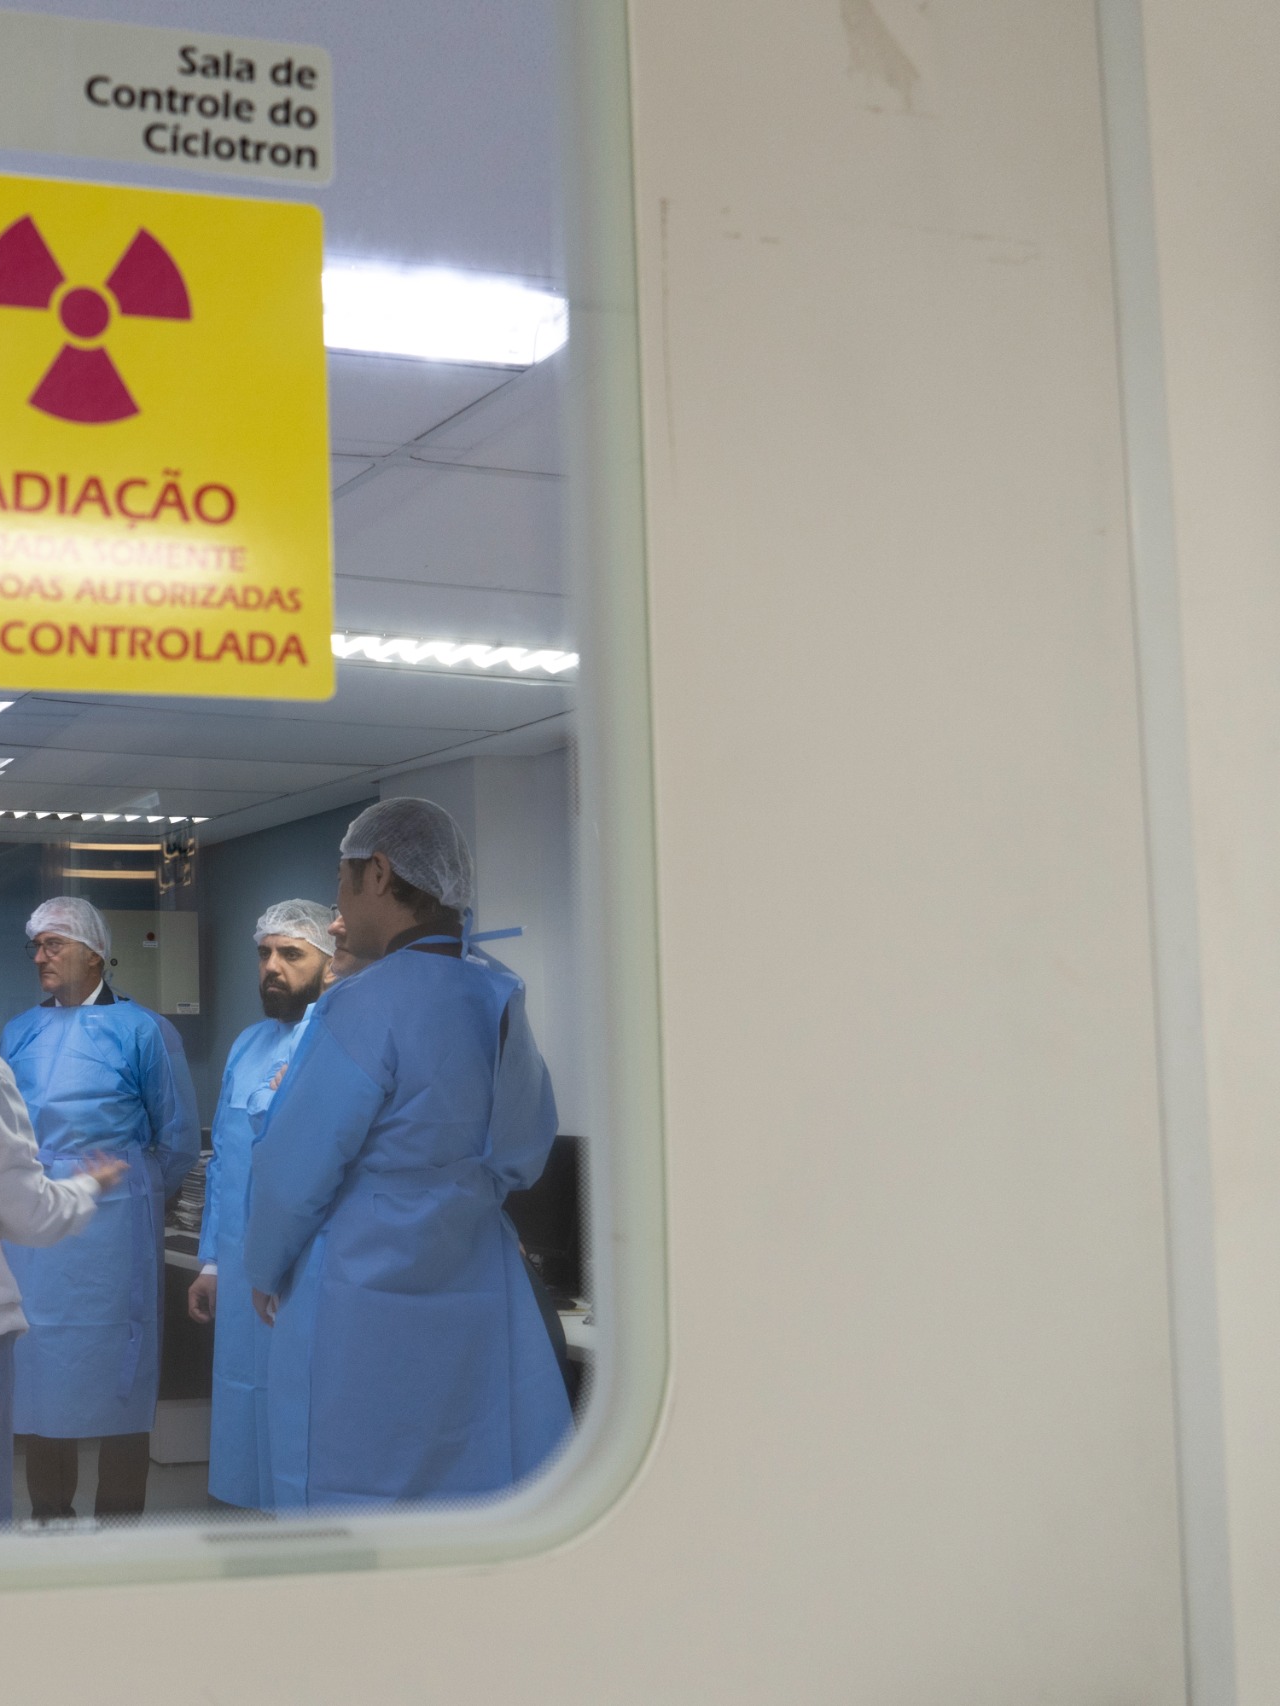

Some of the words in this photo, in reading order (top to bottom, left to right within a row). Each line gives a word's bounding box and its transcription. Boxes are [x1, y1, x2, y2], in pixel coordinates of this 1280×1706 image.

[177, 46, 256, 83] Sala
[269, 59, 317, 89] de
[84, 75, 255, 123] Controle
[268, 97, 317, 129] do
[93, 539, 247, 572] SOMENTE
[75, 581, 301, 613] AUTORIZADAS
